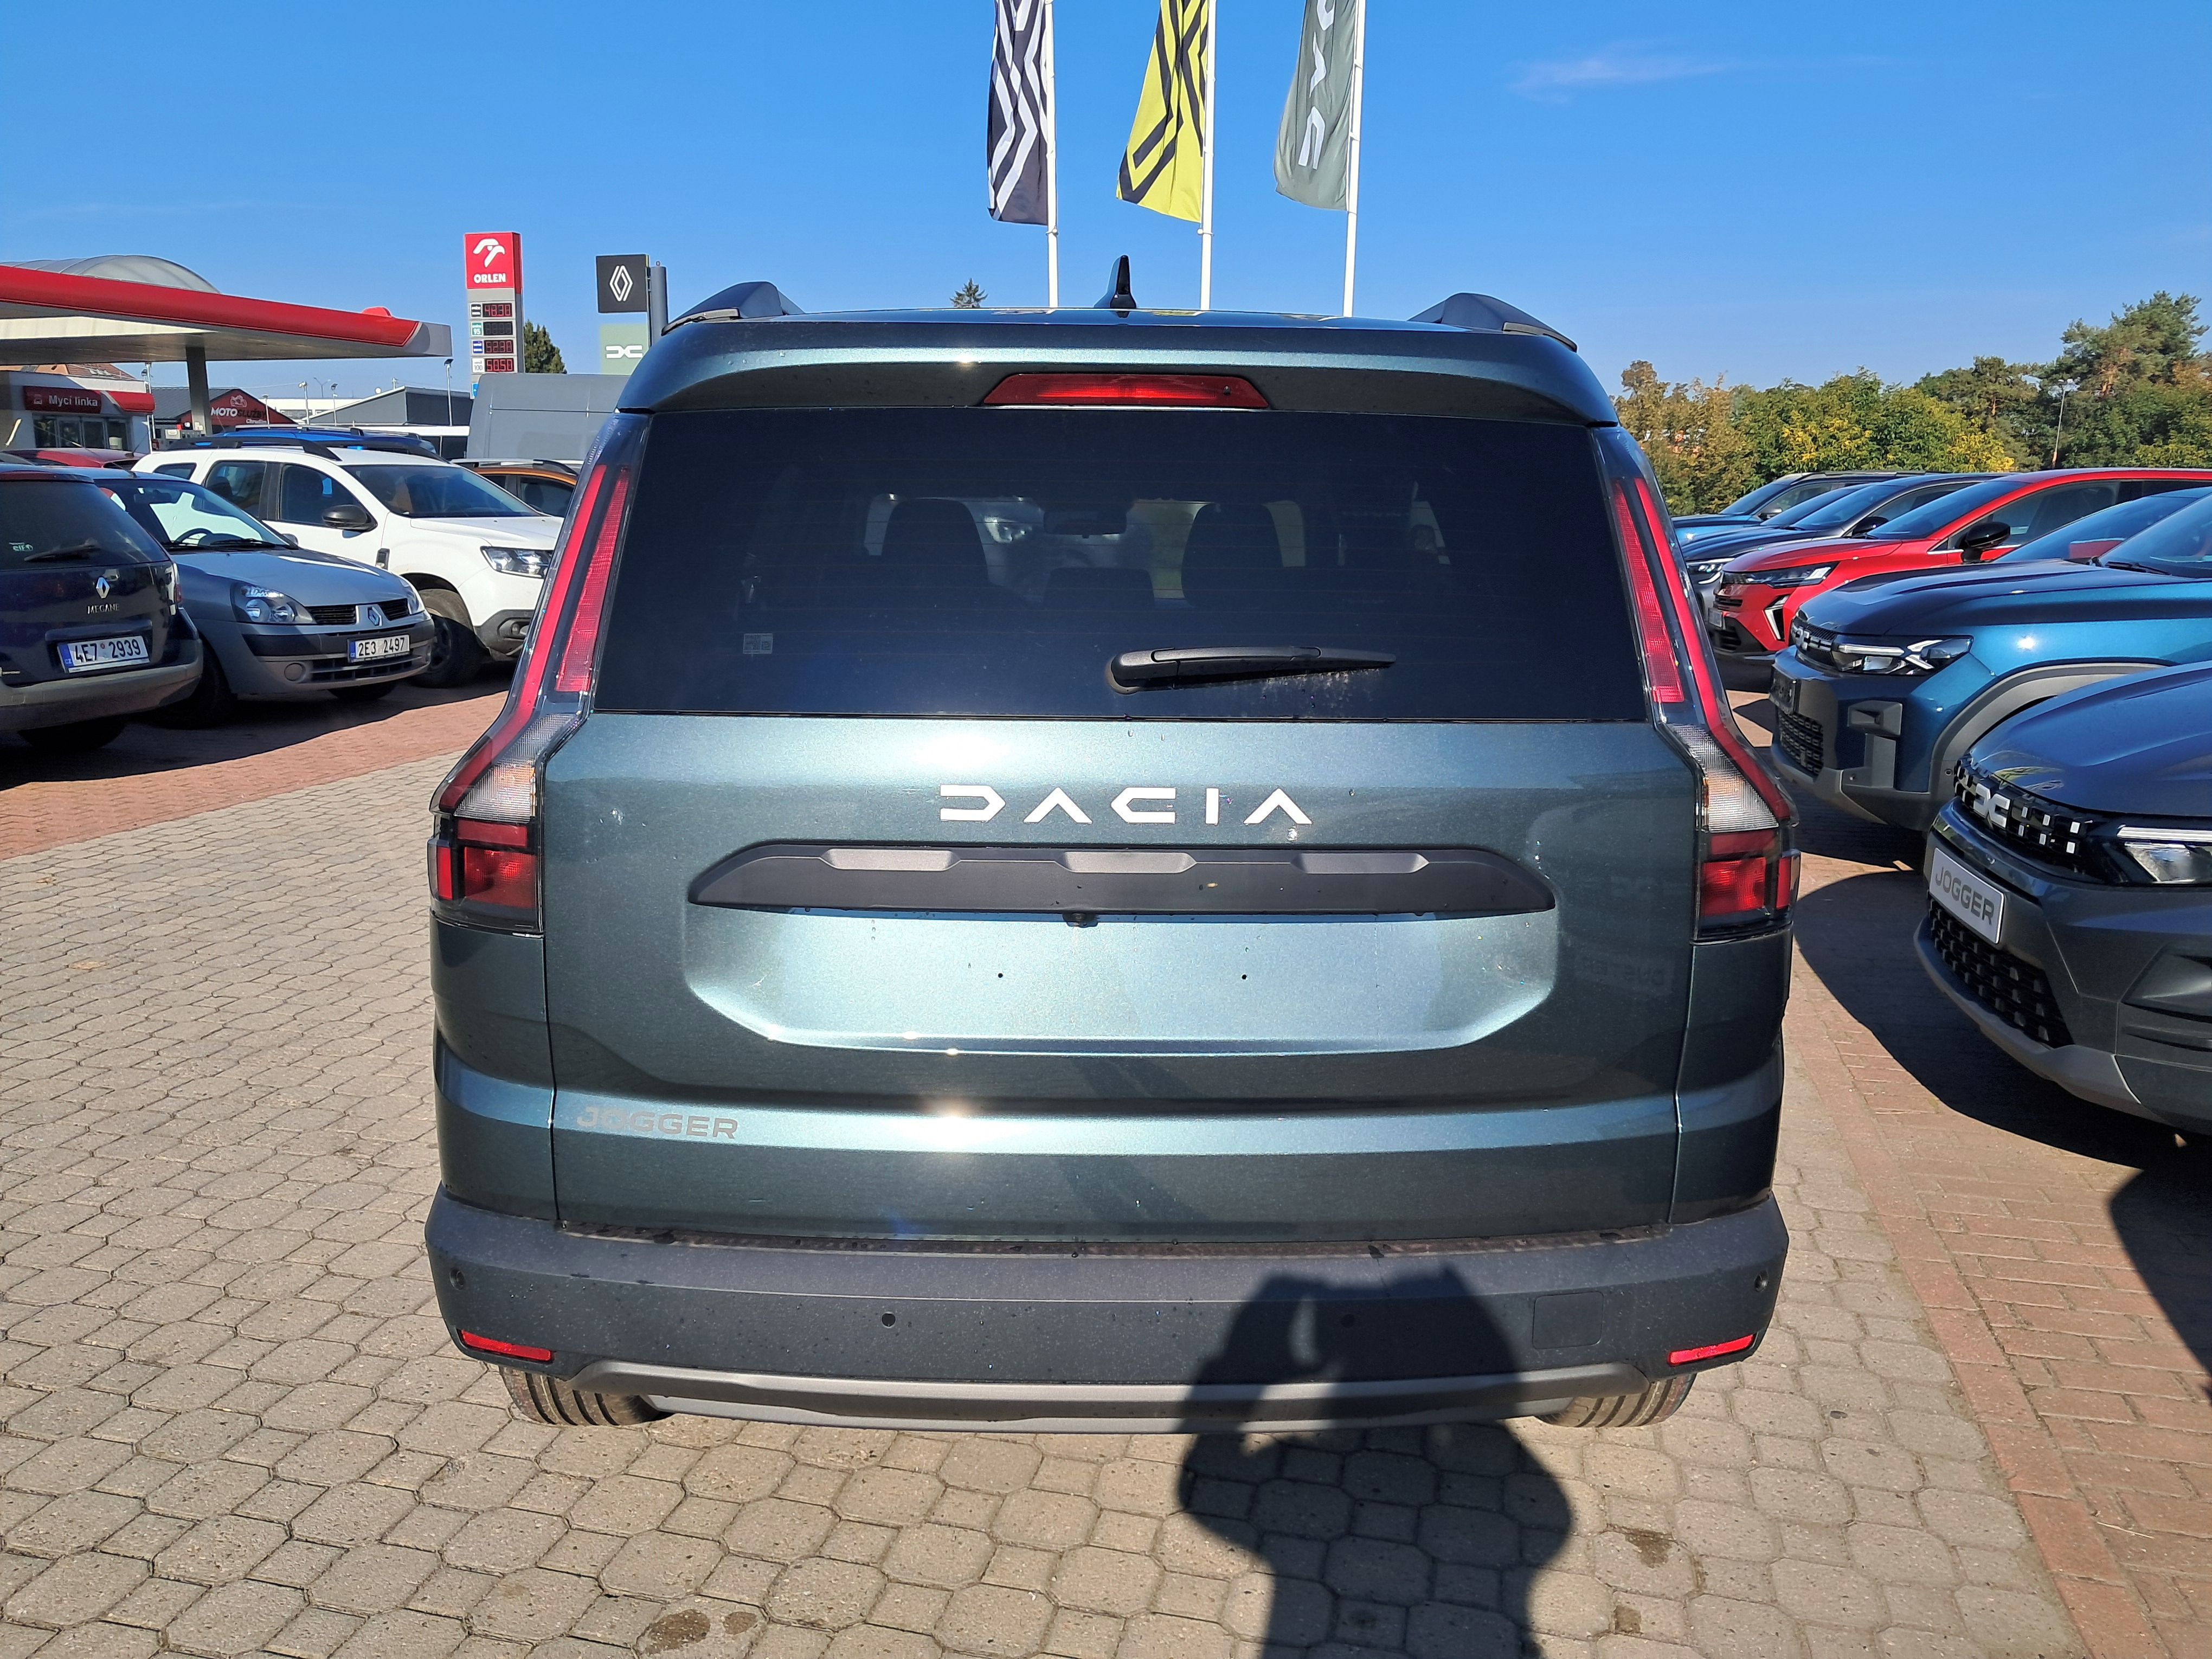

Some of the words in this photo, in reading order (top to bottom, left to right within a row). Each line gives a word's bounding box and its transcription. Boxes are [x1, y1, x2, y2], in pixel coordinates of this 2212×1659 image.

[473, 273, 506, 284] ORLEN
[75, 396, 98, 407] linka
[75, 643, 97, 662] 4E7
[109, 639, 141, 658] 2939
[358, 641, 376, 656] 2E3
[383, 637, 404, 653] 2497
[940, 783, 1313, 825] DACIA
[1935, 866, 1995, 925] JOGGER
[576, 1107, 738, 1139] JOGGER
